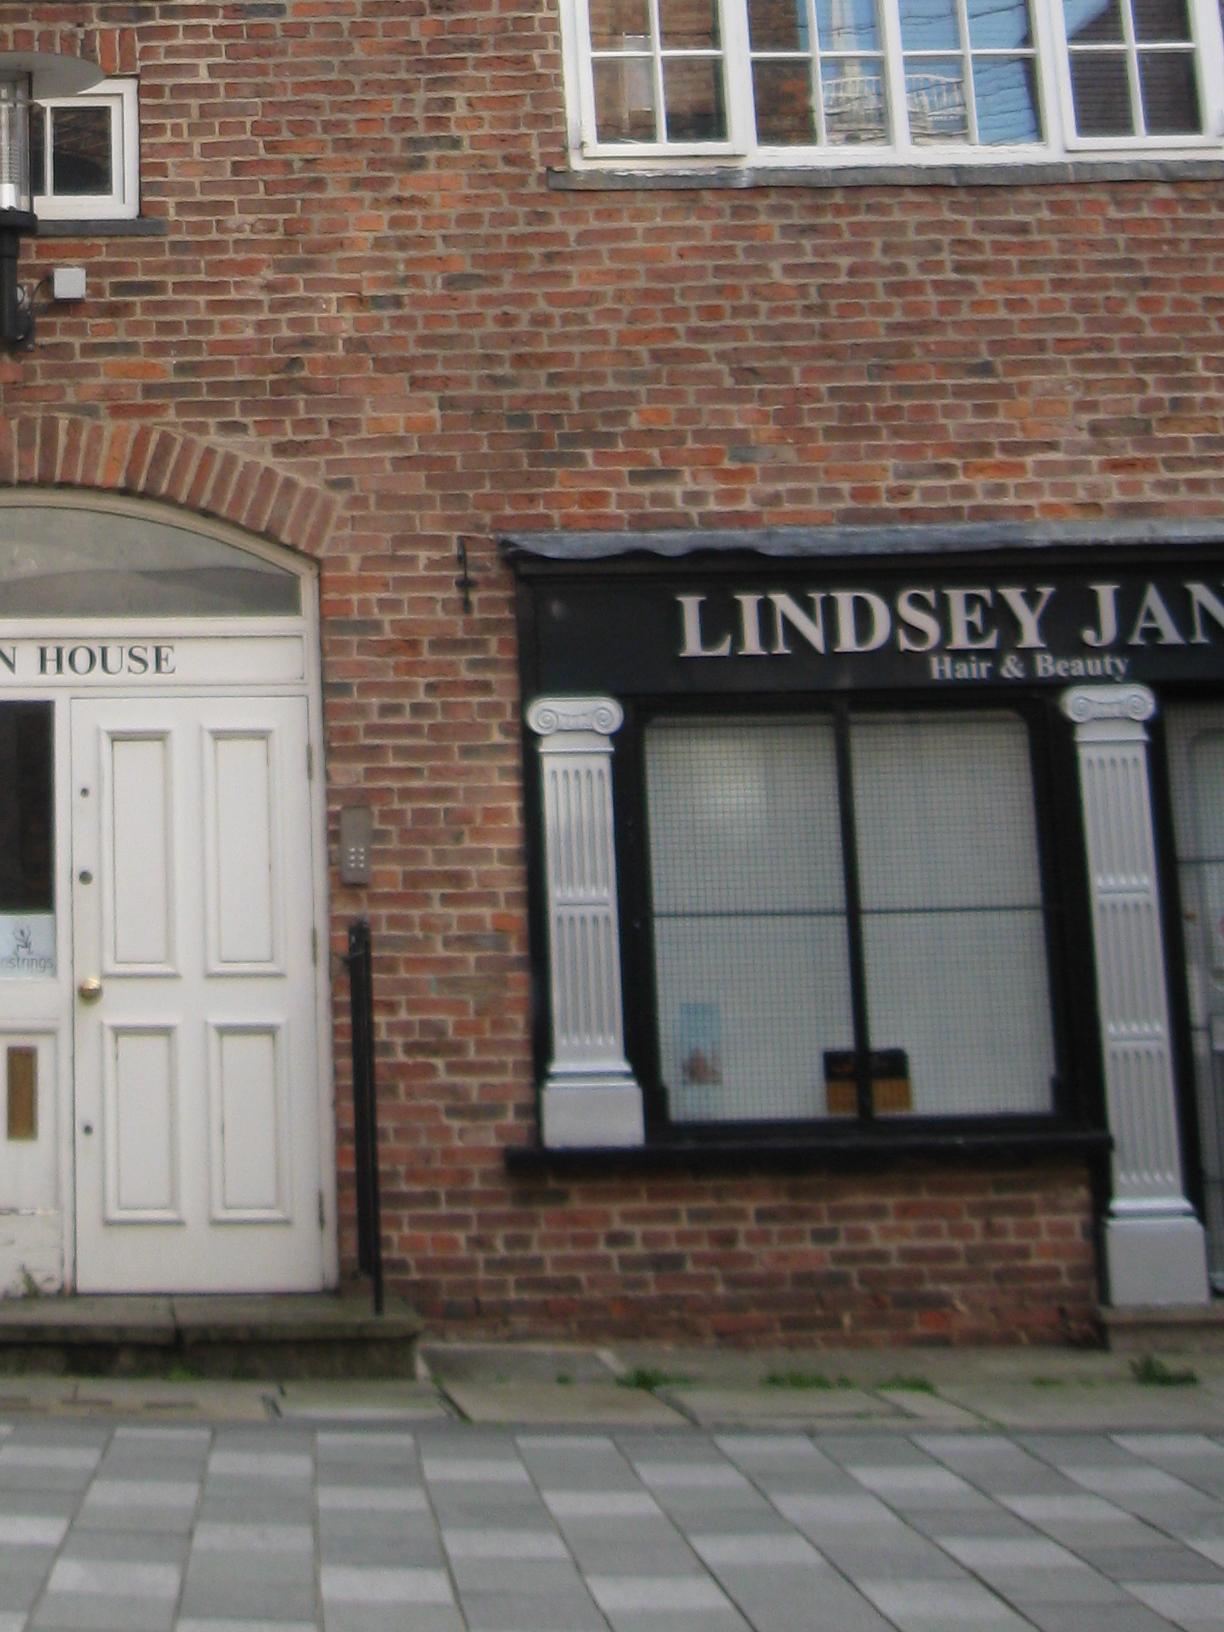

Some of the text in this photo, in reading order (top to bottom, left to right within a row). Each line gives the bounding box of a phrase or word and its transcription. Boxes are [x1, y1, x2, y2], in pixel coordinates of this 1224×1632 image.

[677, 582, 1224, 657] LINDSEY JAN
[37, 645, 176, 675] HOUSE
[929, 653, 1129, 683] Hair & Beauty
